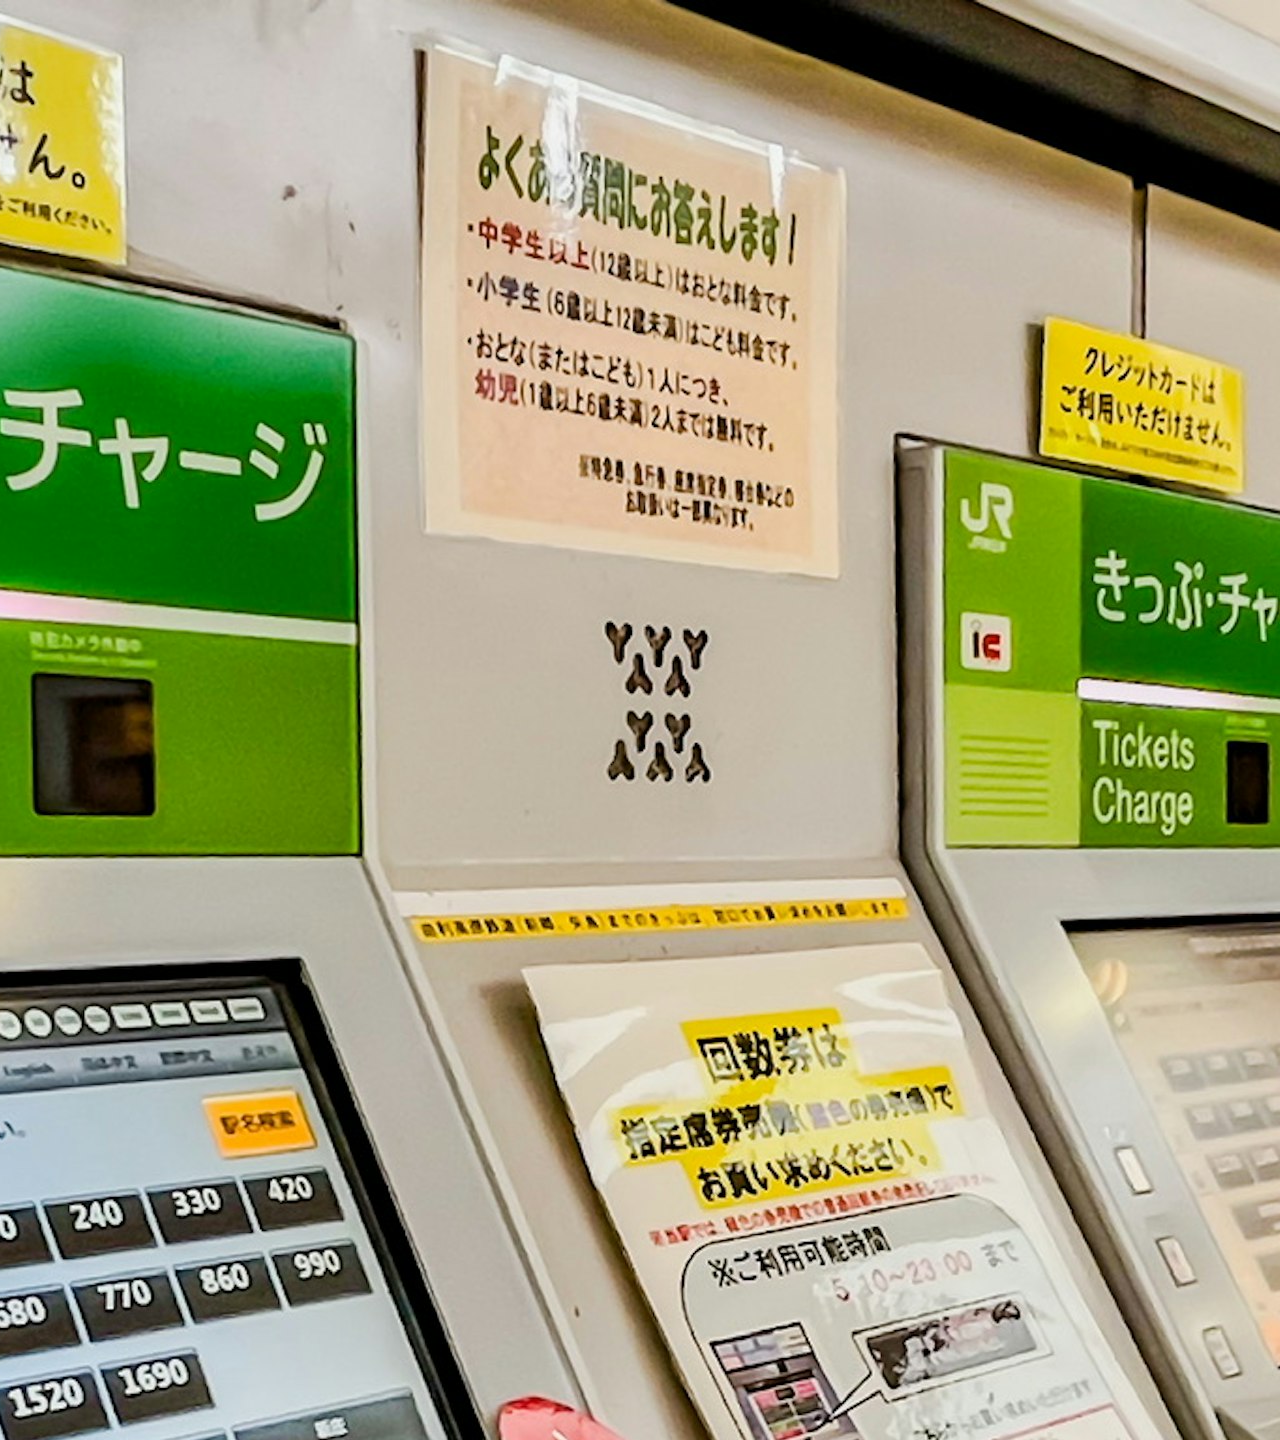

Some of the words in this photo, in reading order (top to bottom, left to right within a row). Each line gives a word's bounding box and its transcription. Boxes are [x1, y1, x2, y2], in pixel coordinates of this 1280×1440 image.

[478, 126, 797, 266] よくあ質問にお答えします！
[960, 483, 1014, 539] JR
[1092, 719, 1195, 771] Tickets
[1092, 777, 1194, 836] Charge
[697, 1024, 848, 1082] 回数券は
[697, 1138, 929, 1202] お買い求めください。
[69, 1199, 124, 1231] 240
[171, 1187, 223, 1217] 330
[267, 1174, 314, 1203] 420
[96, 1279, 154, 1311] 770
[198, 1263, 251, 1296] 860
[293, 1247, 342, 1280] 990
[8, 1378, 86, 1419] 1520
[117, 1358, 189, 1399] 1690
